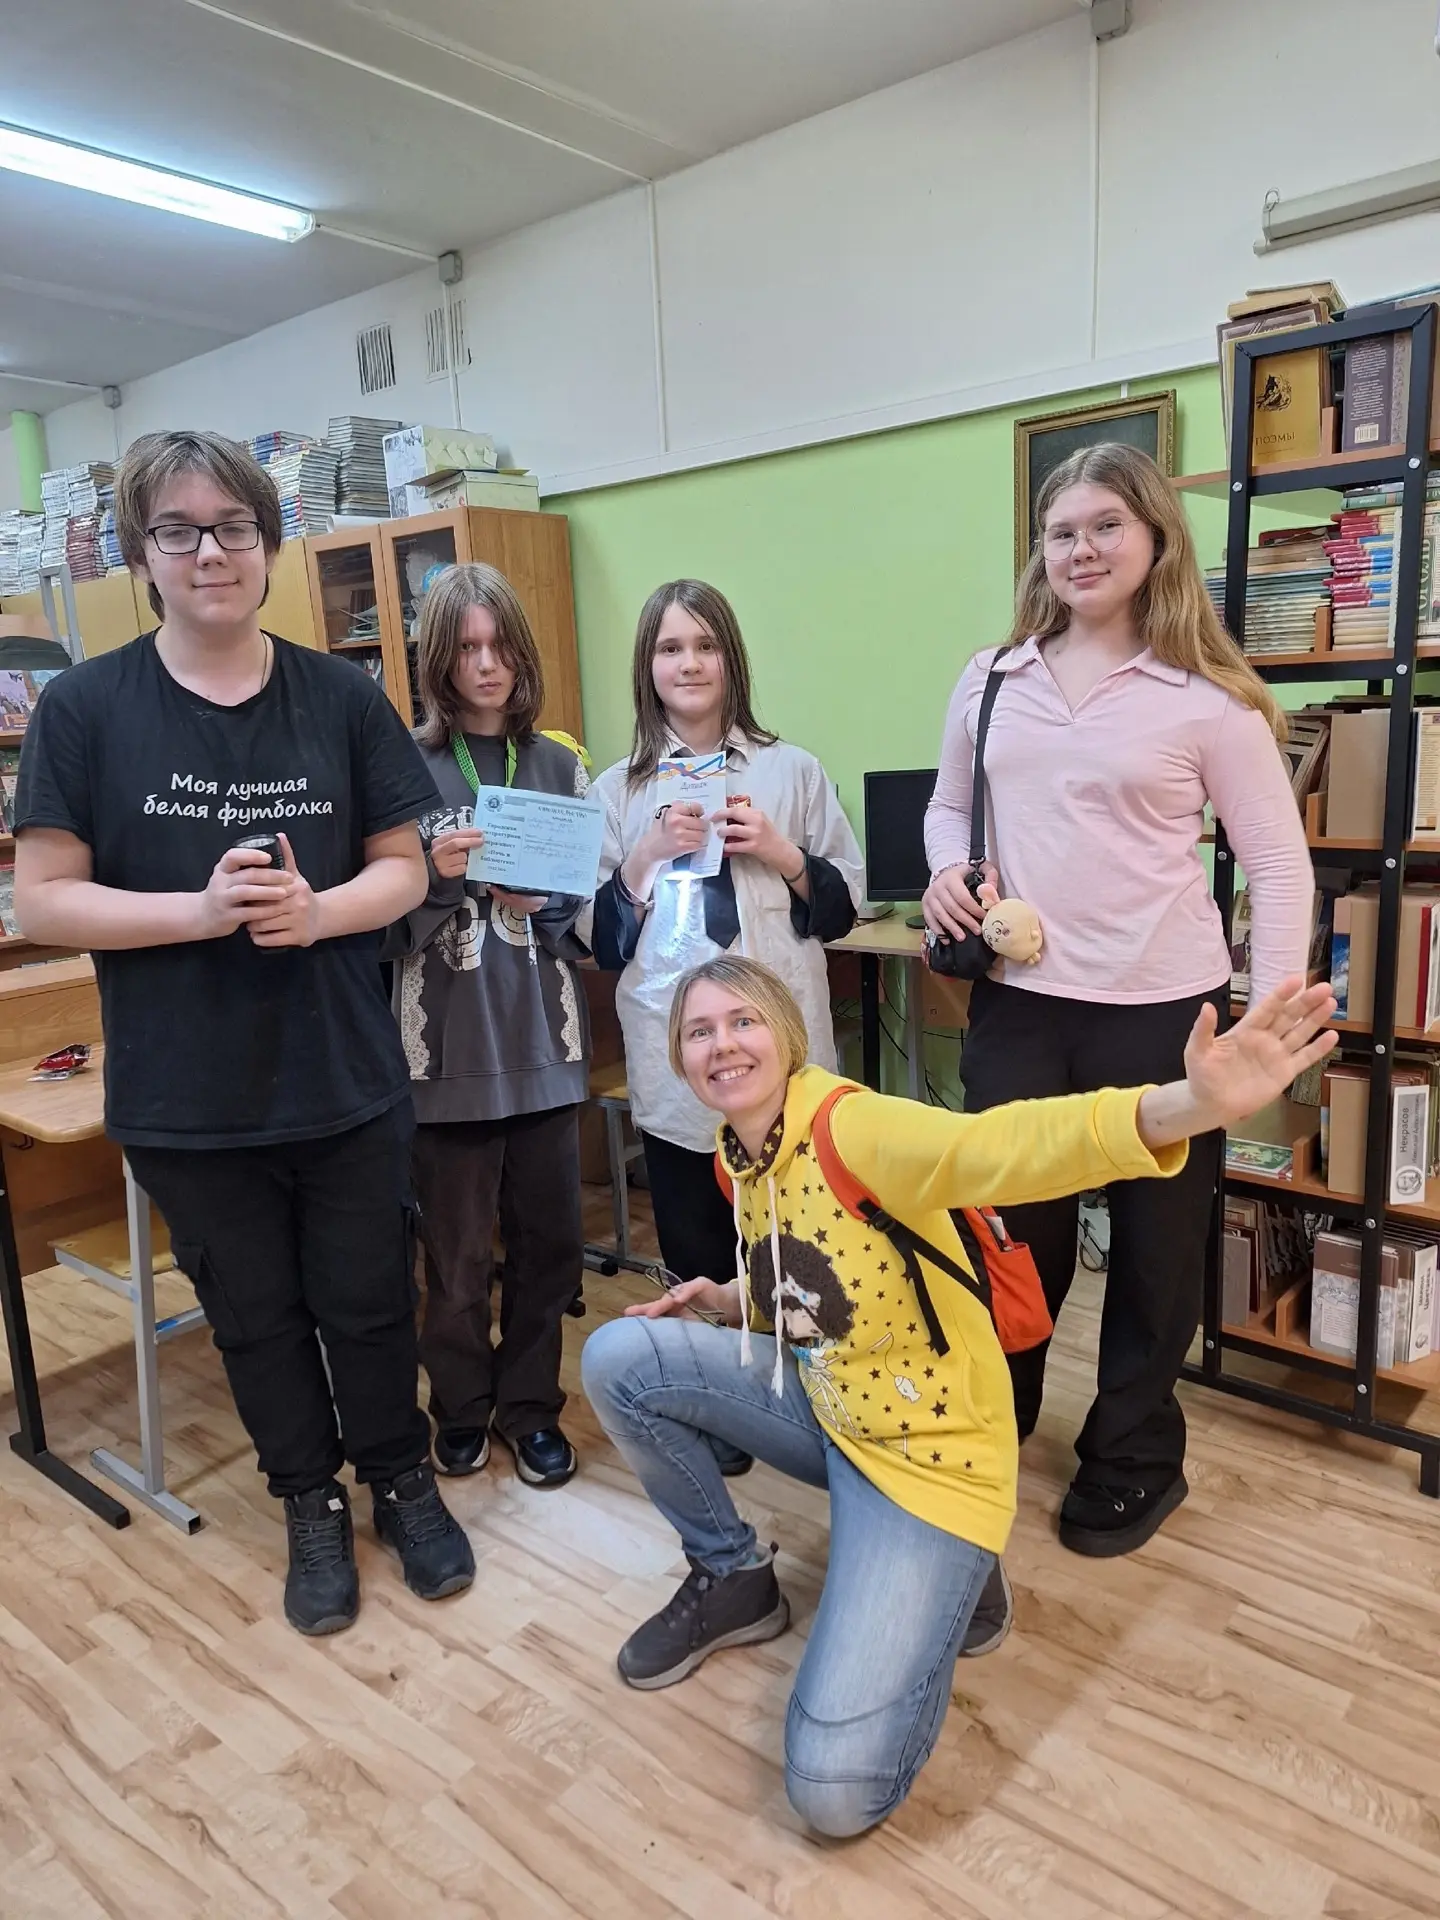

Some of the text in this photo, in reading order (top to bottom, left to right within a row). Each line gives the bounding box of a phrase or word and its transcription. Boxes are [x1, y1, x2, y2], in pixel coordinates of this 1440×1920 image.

[1255, 431, 1295, 446] ПОЭМЫ
[170, 773, 307, 800] Моя лучшая
[143, 794, 333, 827] белая футболка
[1400, 1107, 1409, 1153] Некрасов
